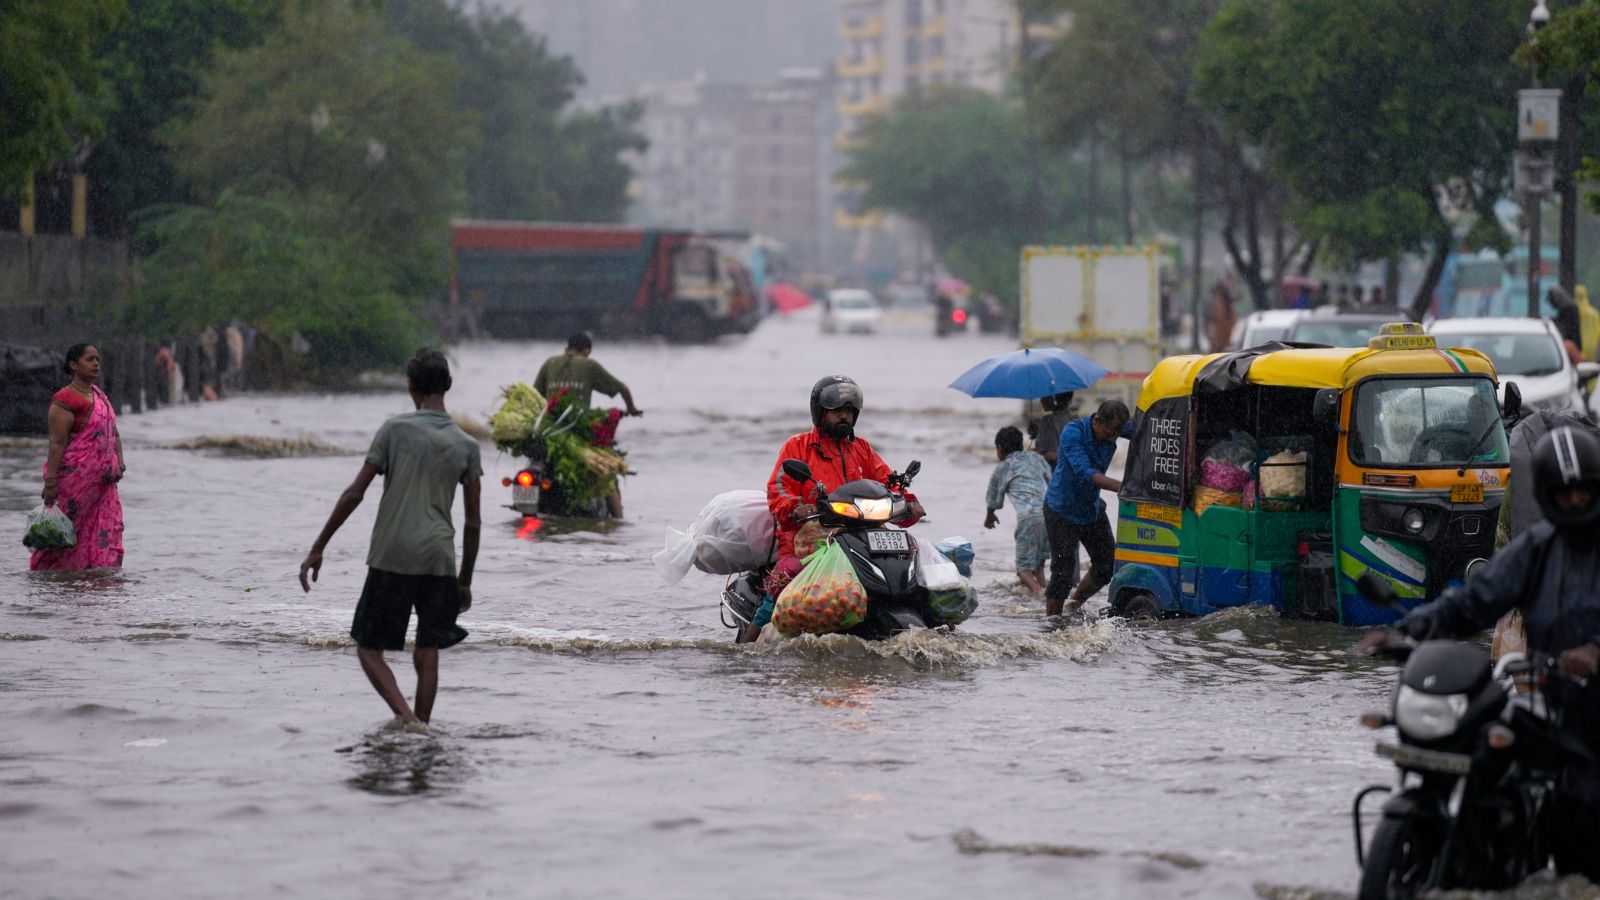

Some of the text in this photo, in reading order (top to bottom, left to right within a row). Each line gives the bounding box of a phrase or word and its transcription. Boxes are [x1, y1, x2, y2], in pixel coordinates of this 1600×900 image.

[1151, 418, 1181, 436] THREE
[1151, 437, 1180, 455] RIDES
[1154, 457, 1179, 474] FREE
[1151, 481, 1180, 493] Uber Auto
[1137, 528, 1156, 540] NCR
